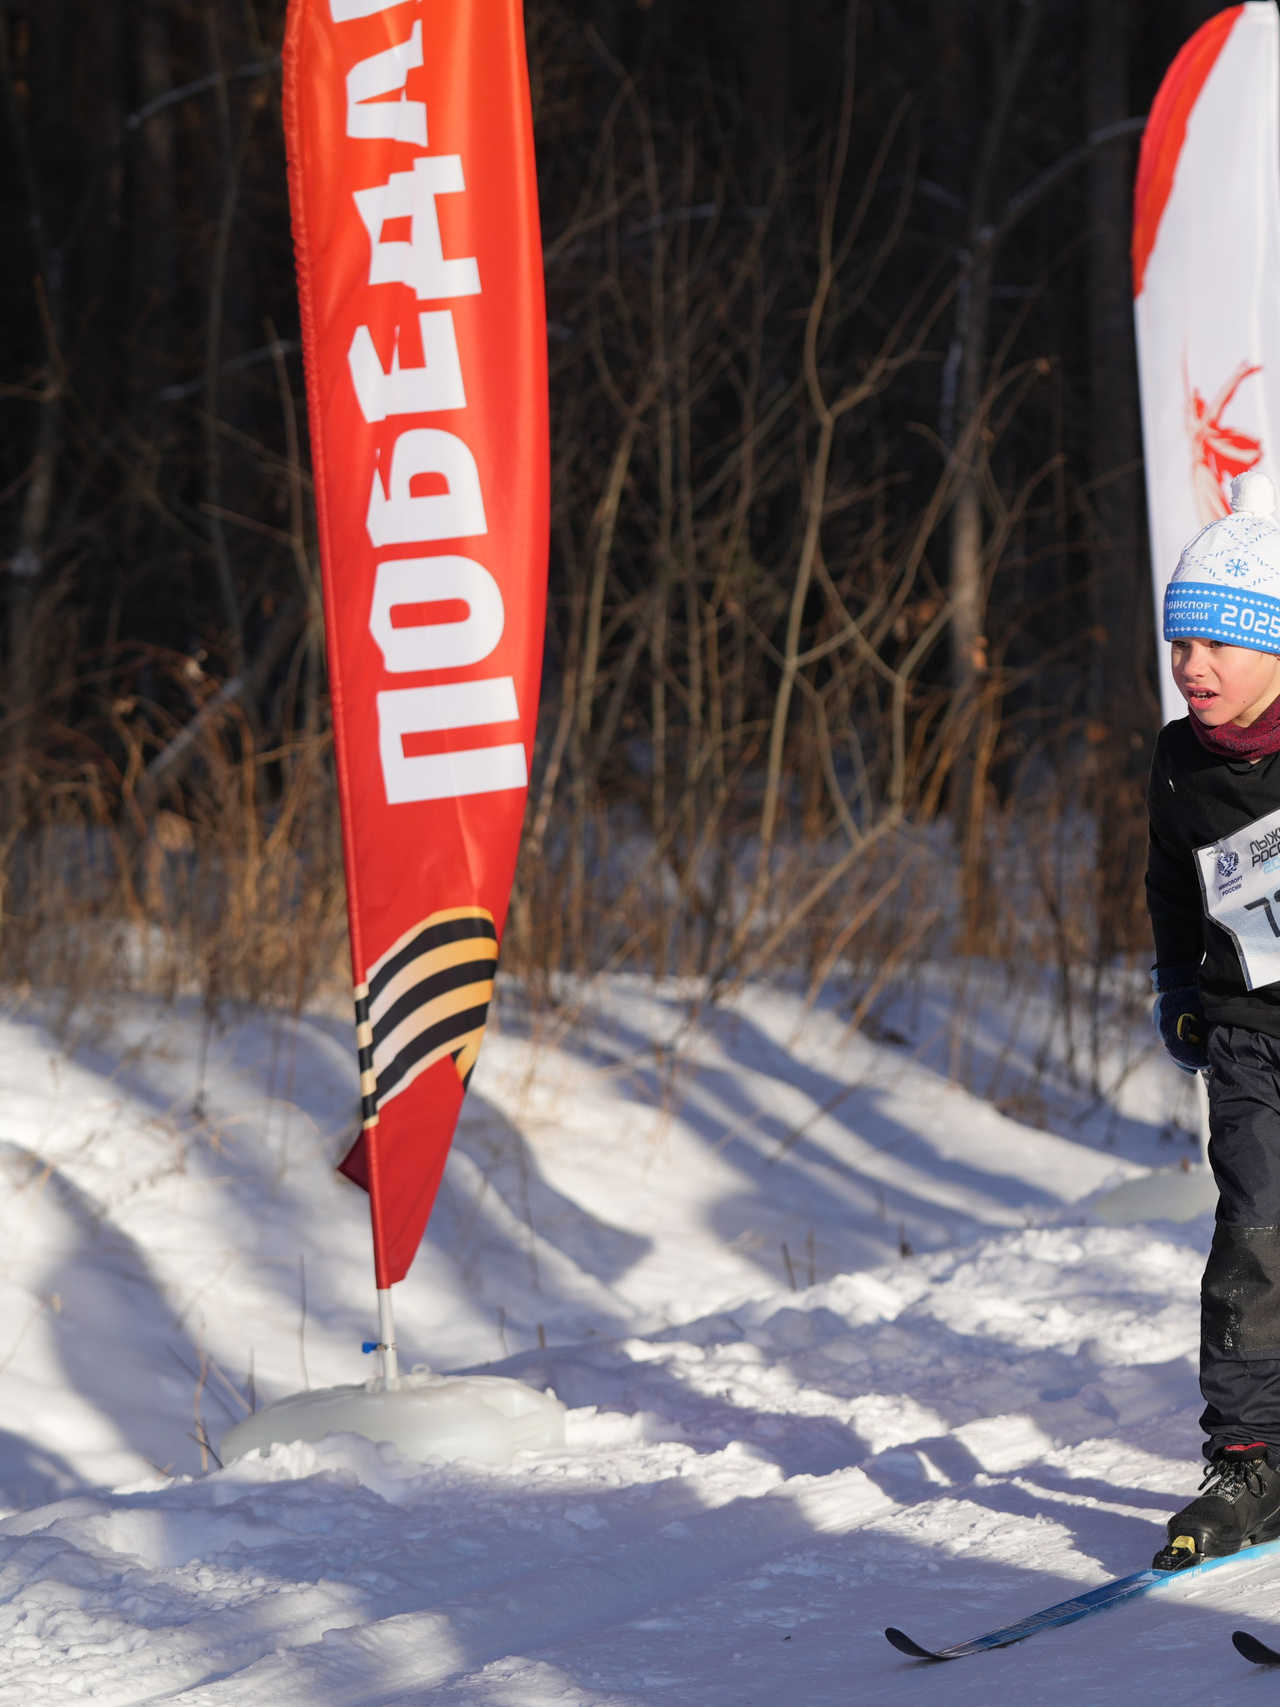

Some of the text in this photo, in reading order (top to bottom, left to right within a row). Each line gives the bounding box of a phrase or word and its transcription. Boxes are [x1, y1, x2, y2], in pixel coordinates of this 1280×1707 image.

[329, 0, 528, 804] ПОБЕДА
[1169, 611, 1209, 621] РОССИИ
[1221, 883, 1243, 896] РОССИИ
